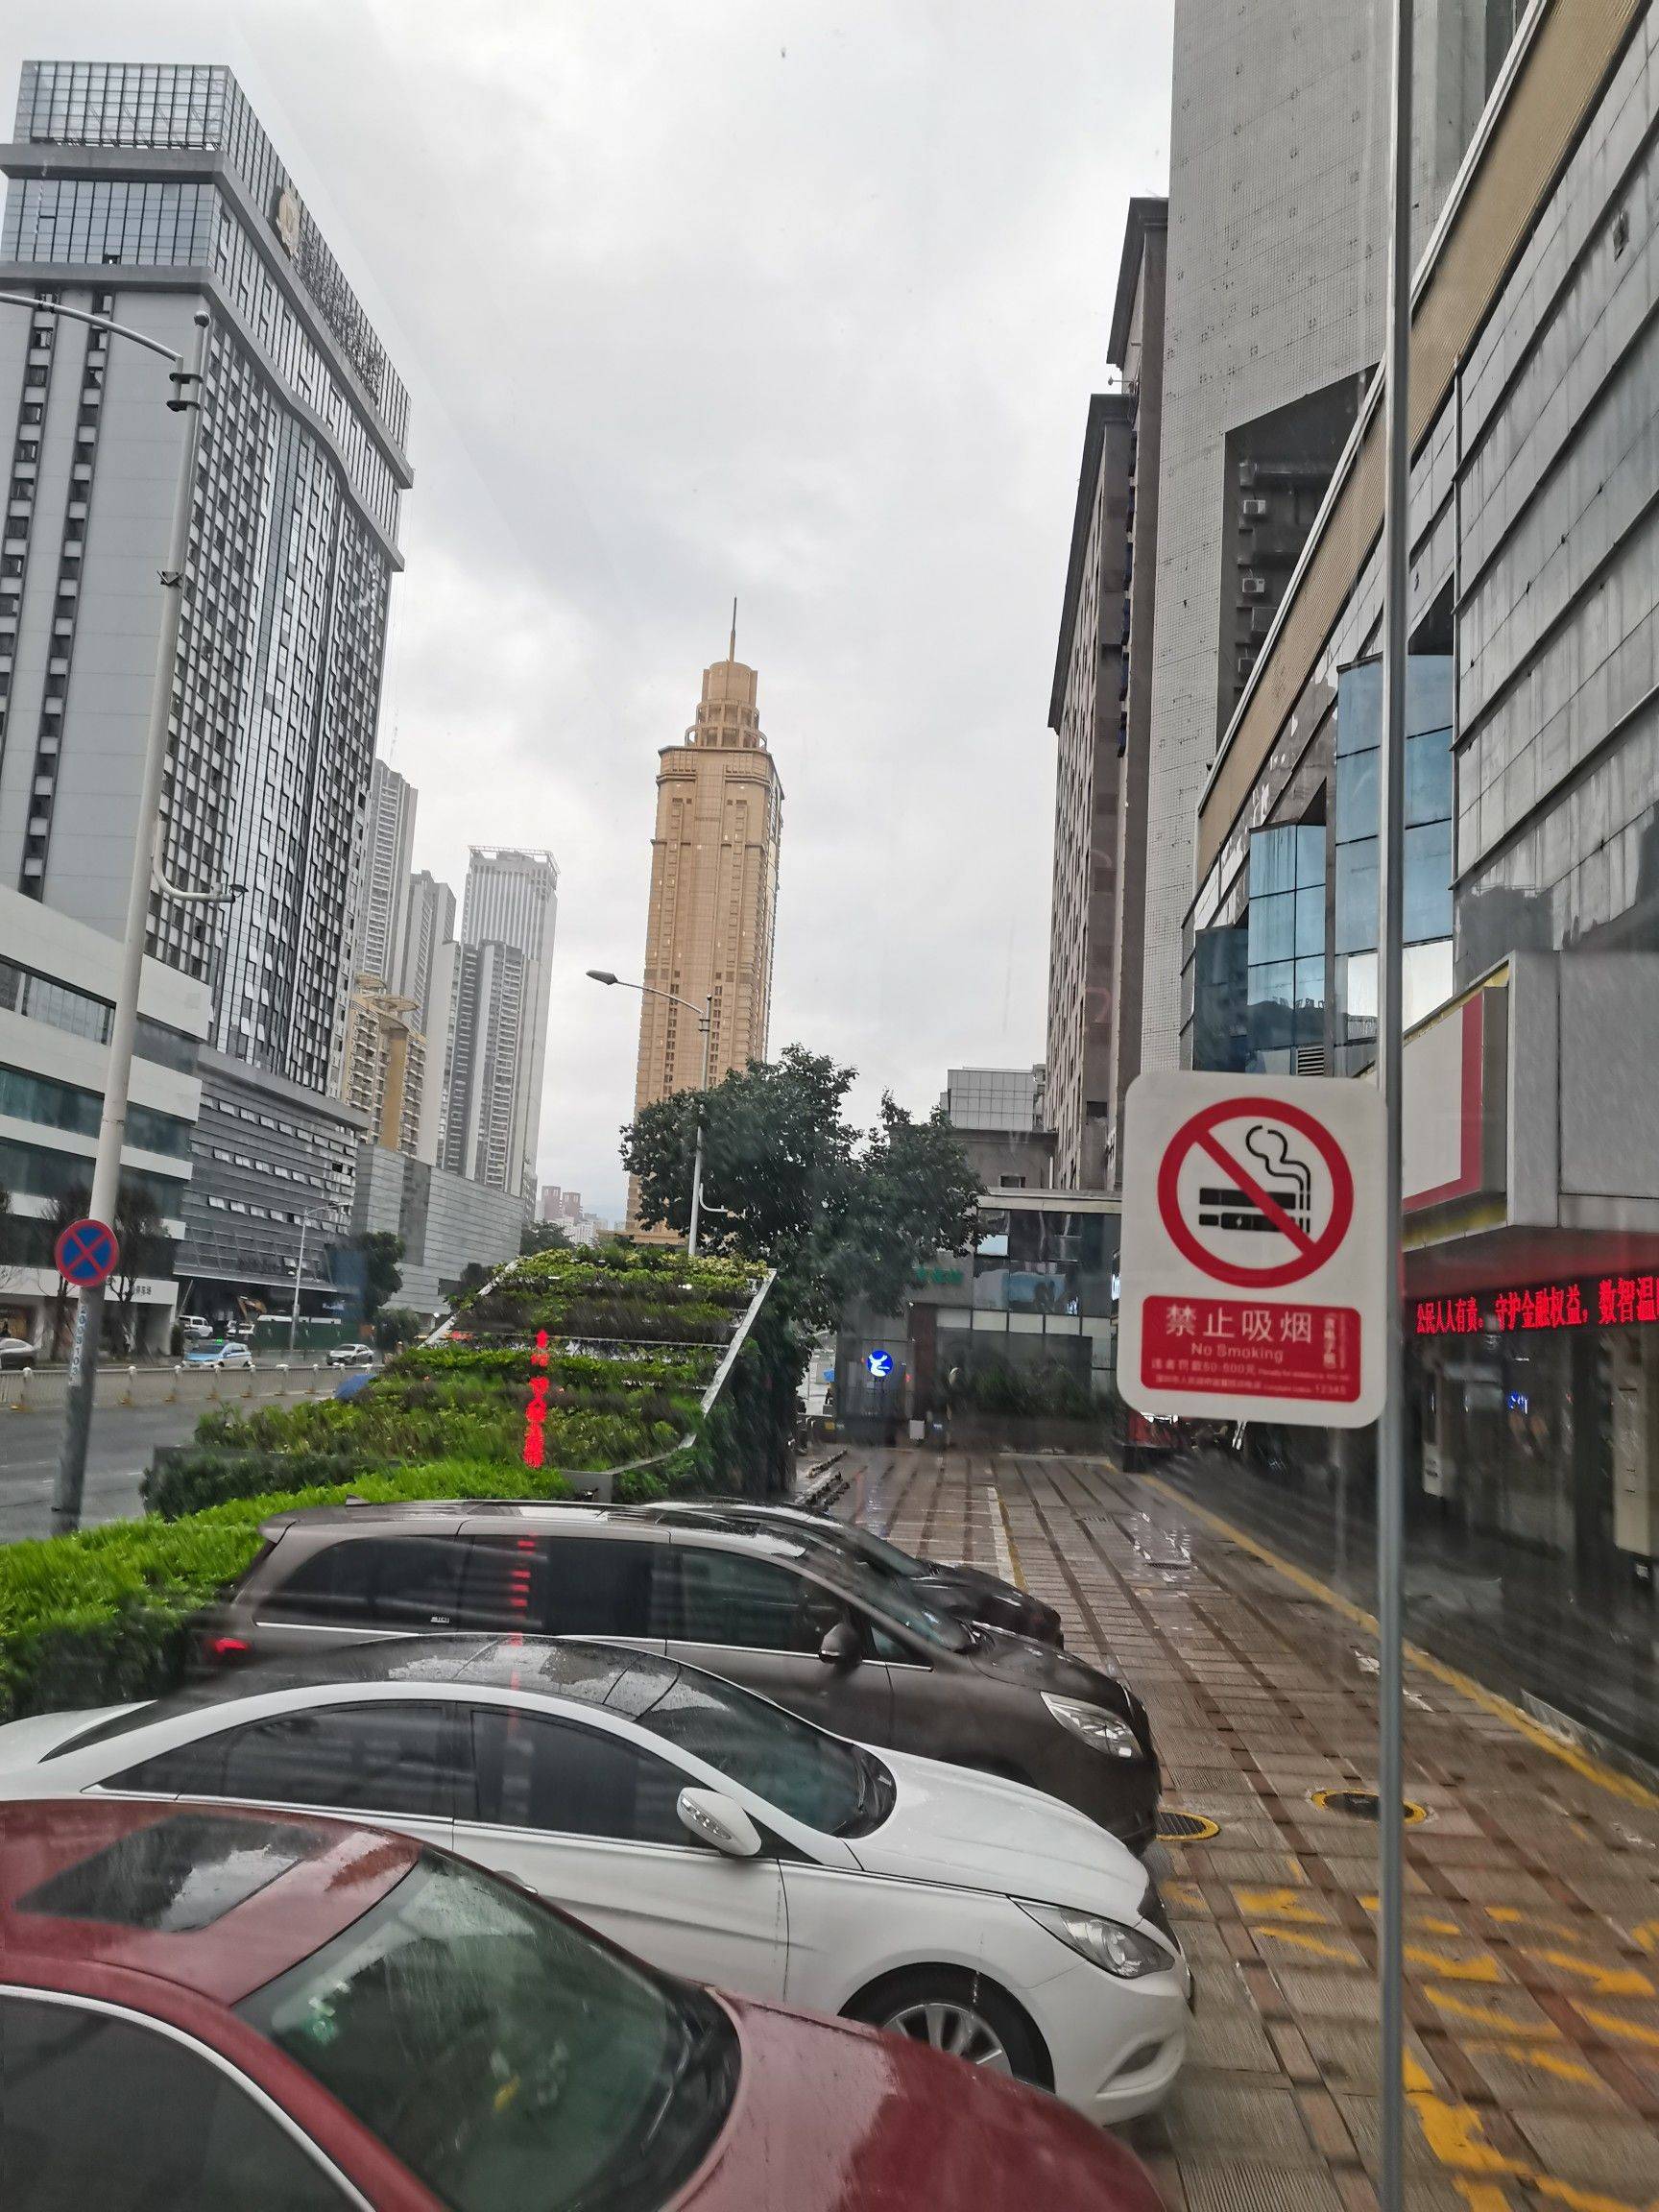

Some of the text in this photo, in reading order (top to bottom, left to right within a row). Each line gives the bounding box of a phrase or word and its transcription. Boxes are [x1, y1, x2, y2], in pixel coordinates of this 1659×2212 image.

[1166, 1303, 1311, 1344] 禁止吸烟
[1191, 1342, 1284, 1363] No Smoking
